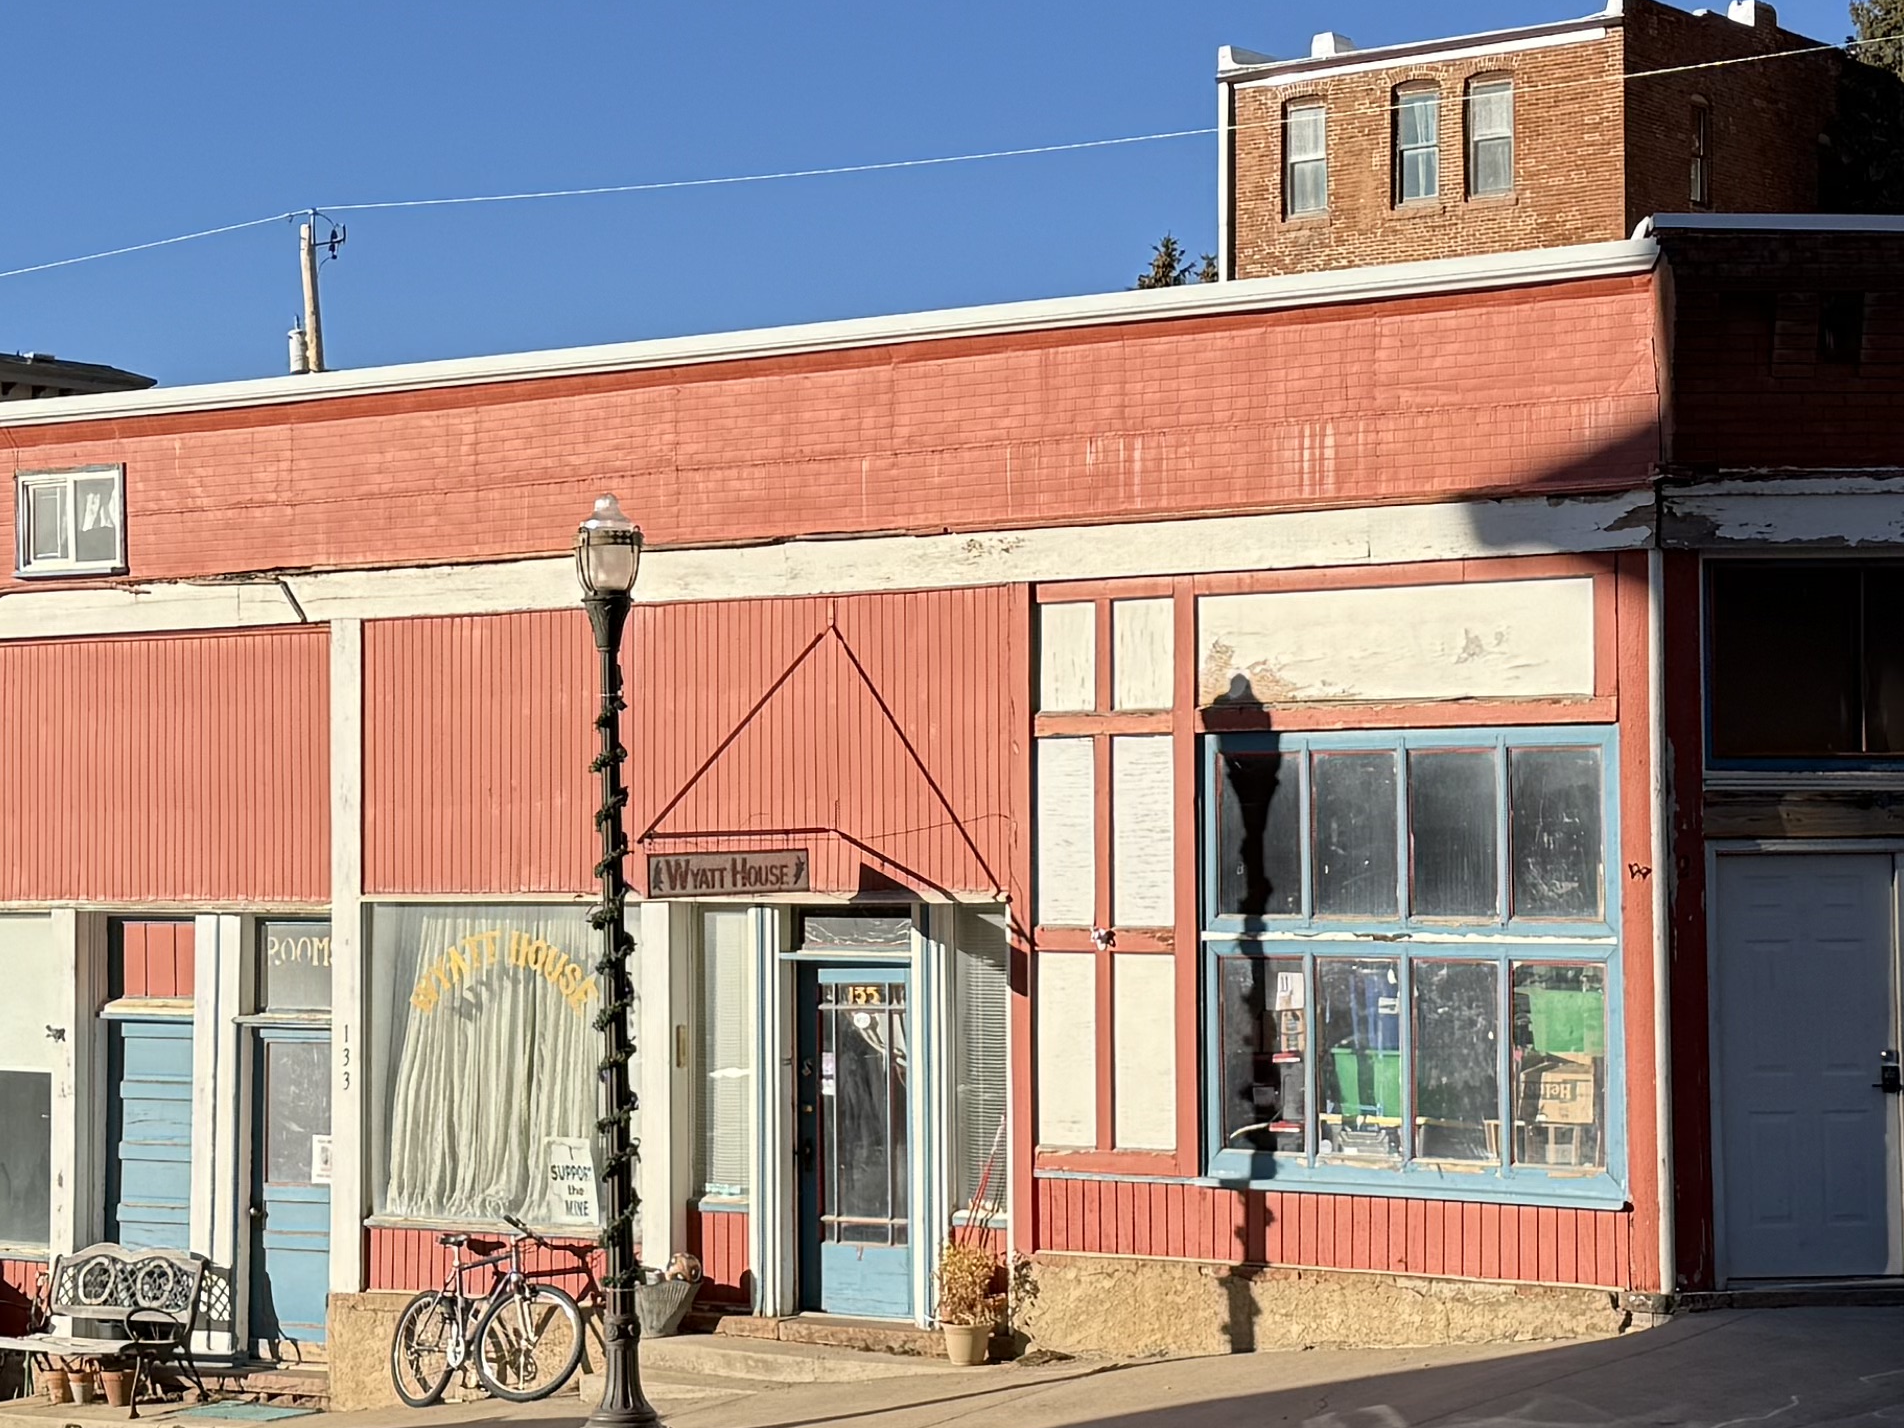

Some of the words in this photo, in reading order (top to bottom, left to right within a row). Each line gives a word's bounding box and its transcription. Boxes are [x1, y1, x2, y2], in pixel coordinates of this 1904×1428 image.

[665, 858, 727, 891] WYATT
[731, 857, 790, 888] HOUSE
[268, 936, 333, 967] ROOM
[410, 930, 501, 1015] WYATT
[508, 930, 599, 1019] HOUSE
